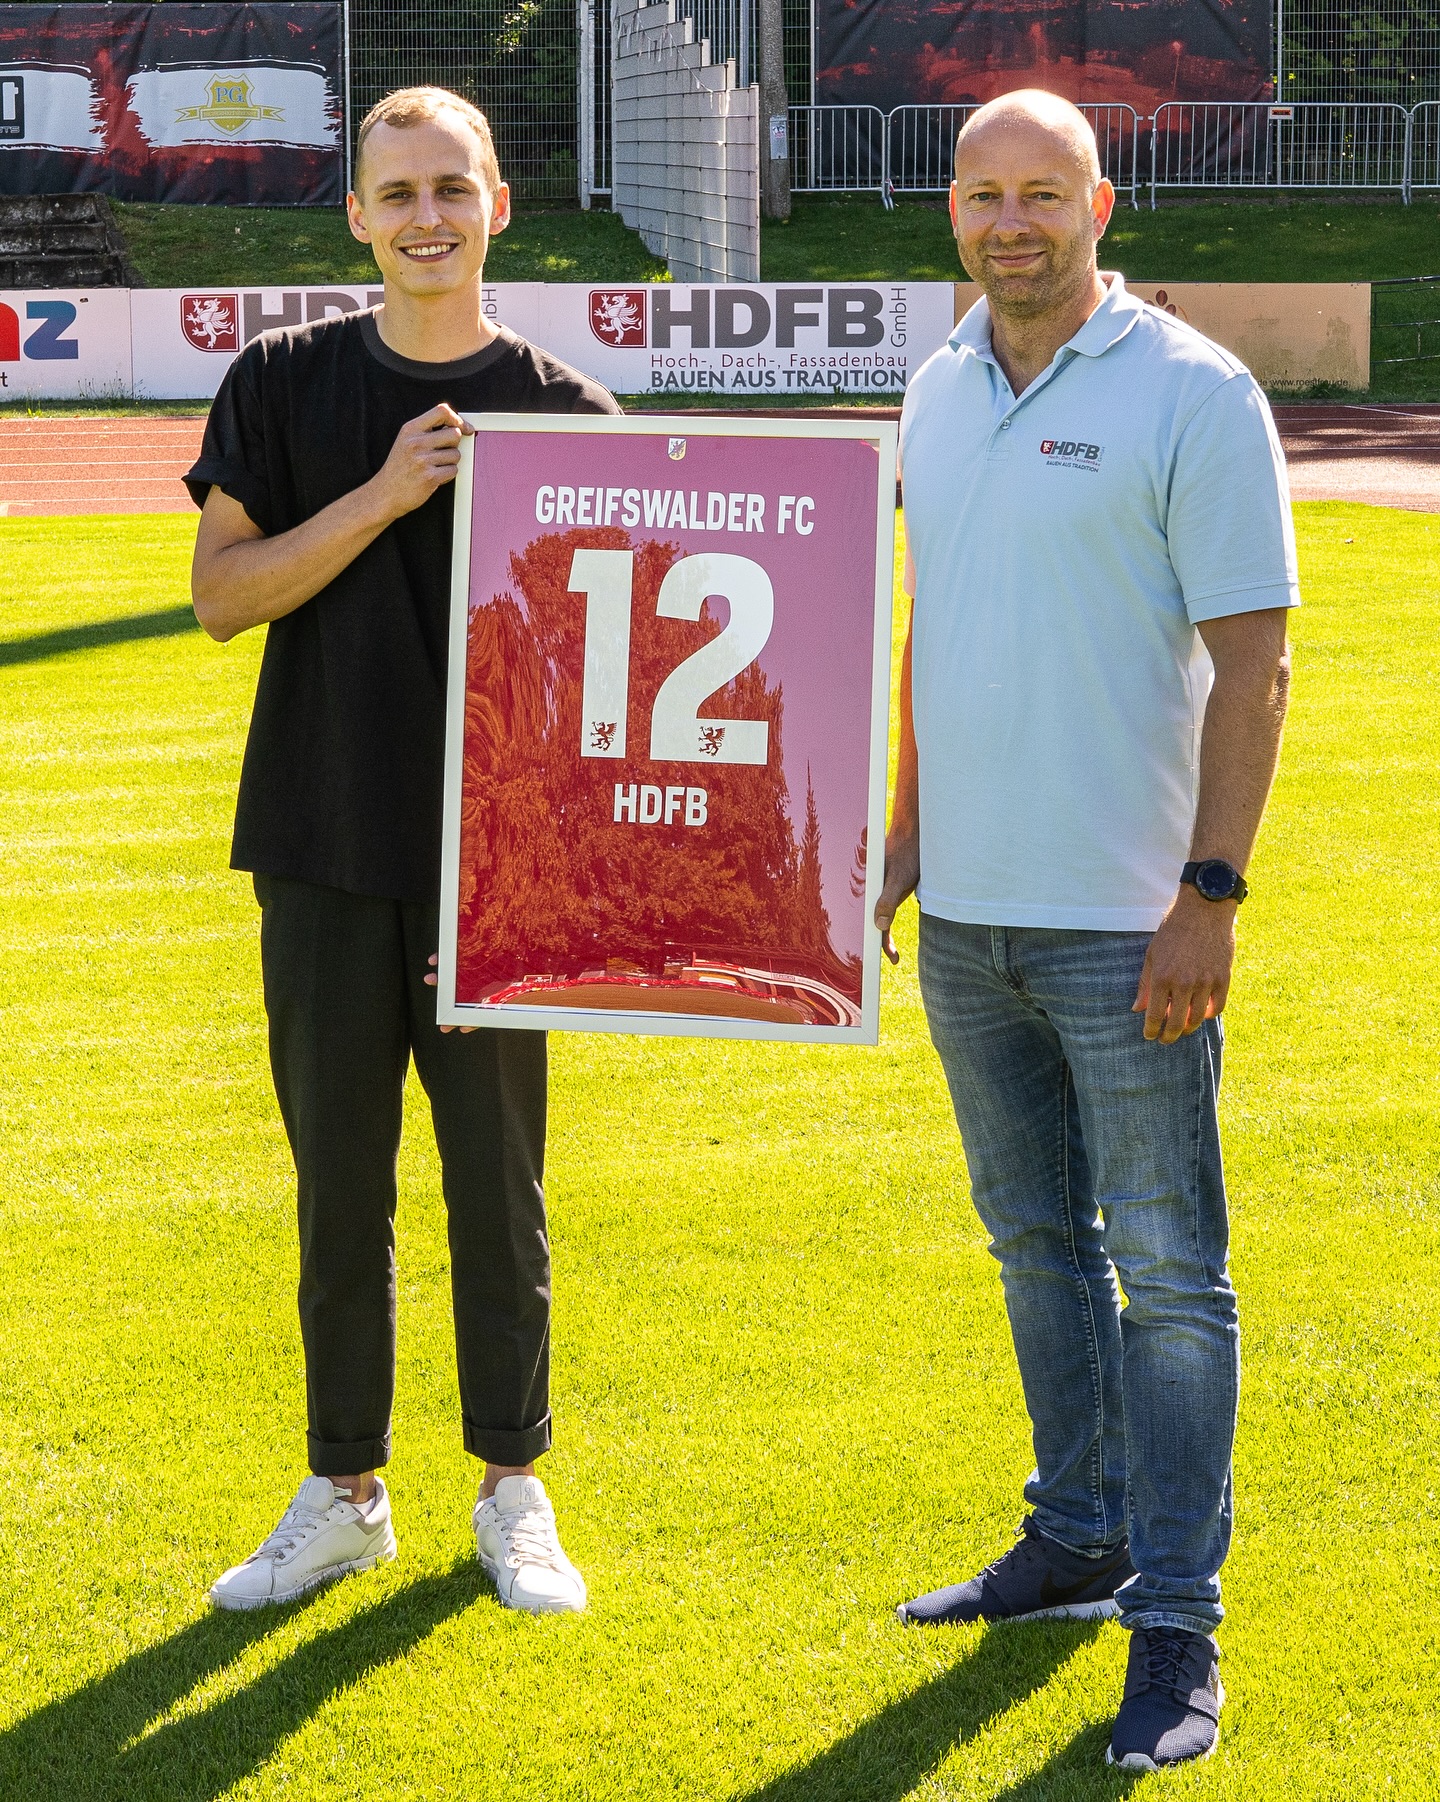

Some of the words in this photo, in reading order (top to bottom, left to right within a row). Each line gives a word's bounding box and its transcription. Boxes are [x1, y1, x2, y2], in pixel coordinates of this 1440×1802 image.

[652, 289, 885, 348] HDFB
[889, 287, 907, 348] GmbH
[651, 352, 713, 370] Hoch-,
[721, 352, 780, 370] Dach-,
[790, 352, 907, 368] Fassadenbau
[651, 370, 725, 388] BAUEN
[731, 370, 777, 388] AUS
[782, 369, 907, 388] TRADITION
[1051, 441, 1100, 459] HDFB
[1072, 463, 1099, 472] TRADITION
[535, 485, 766, 533] GREIFSWALDER
[777, 495, 816, 536] FC
[567, 548, 775, 766] 12
[613, 783, 709, 827] HDFB
